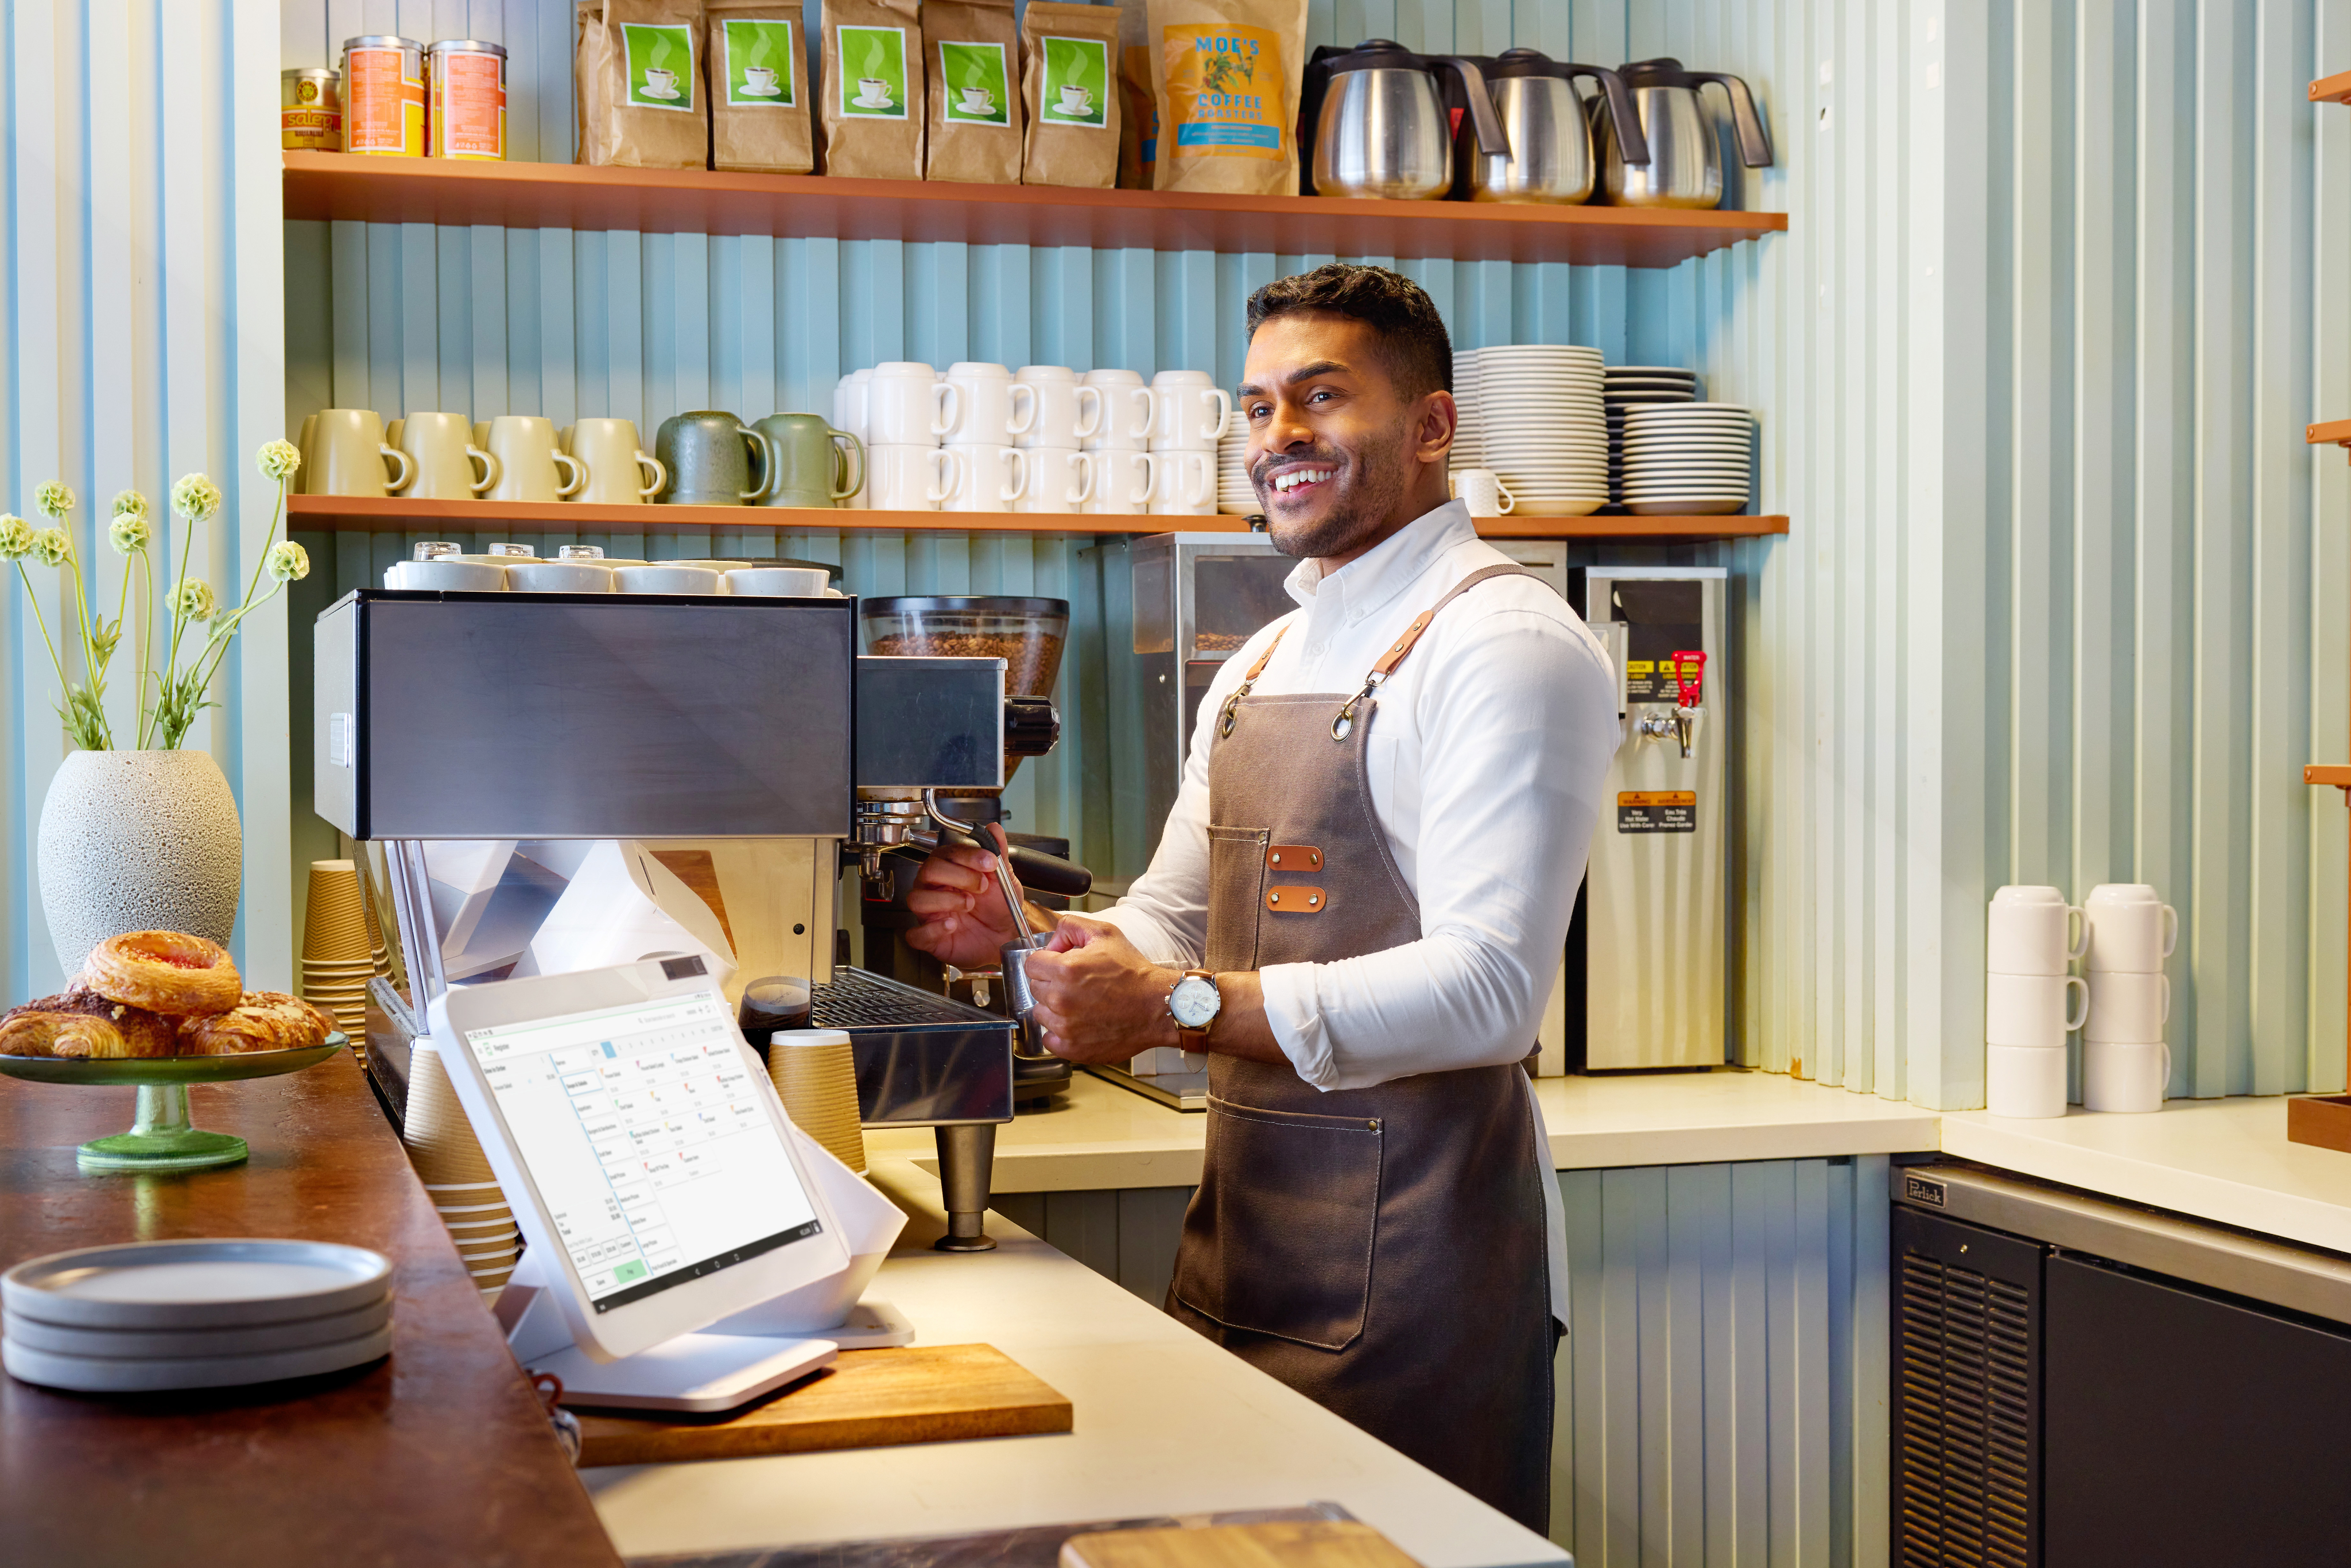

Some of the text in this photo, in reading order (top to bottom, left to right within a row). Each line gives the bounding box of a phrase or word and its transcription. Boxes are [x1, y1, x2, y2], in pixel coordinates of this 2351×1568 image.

[1196, 37, 1259, 55] MOE'S
[1198, 94, 1262, 108] COFFEE
[288, 108, 333, 133] salep
[1198, 109, 1262, 120] ROASTERS
[1909, 1180, 1941, 1203] Perlick
